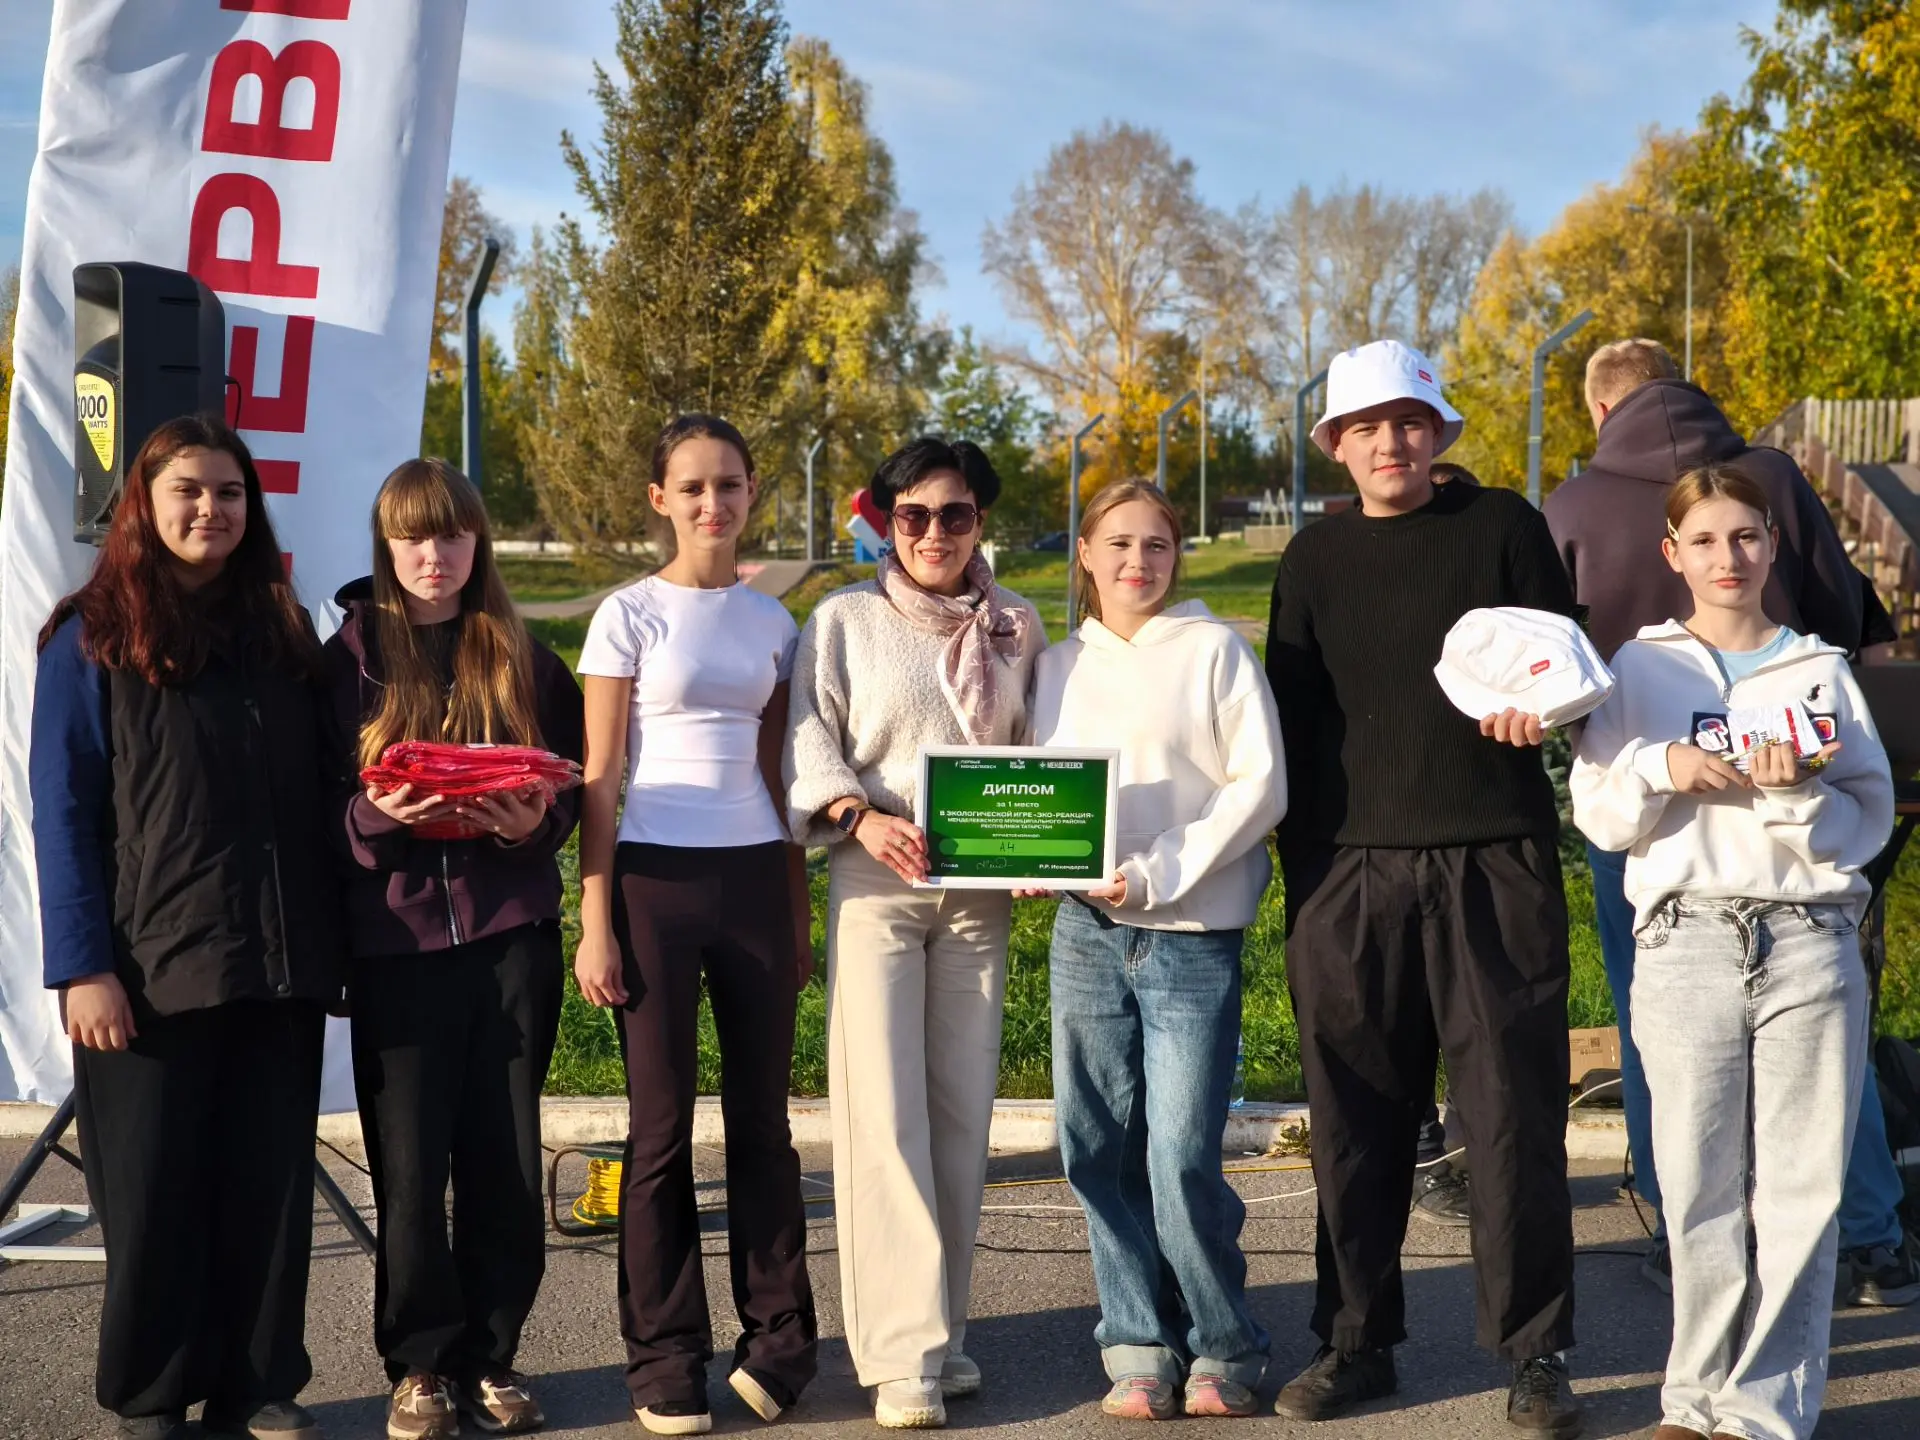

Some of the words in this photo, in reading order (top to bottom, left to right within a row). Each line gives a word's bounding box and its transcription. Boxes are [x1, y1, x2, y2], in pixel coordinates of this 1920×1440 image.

[186, 0, 350, 584] ЕРВ
[982, 783, 1055, 796] ДИПЛОМ
[946, 810, 1013, 818] ЭКОЛОГИЧЕСКОЙ
